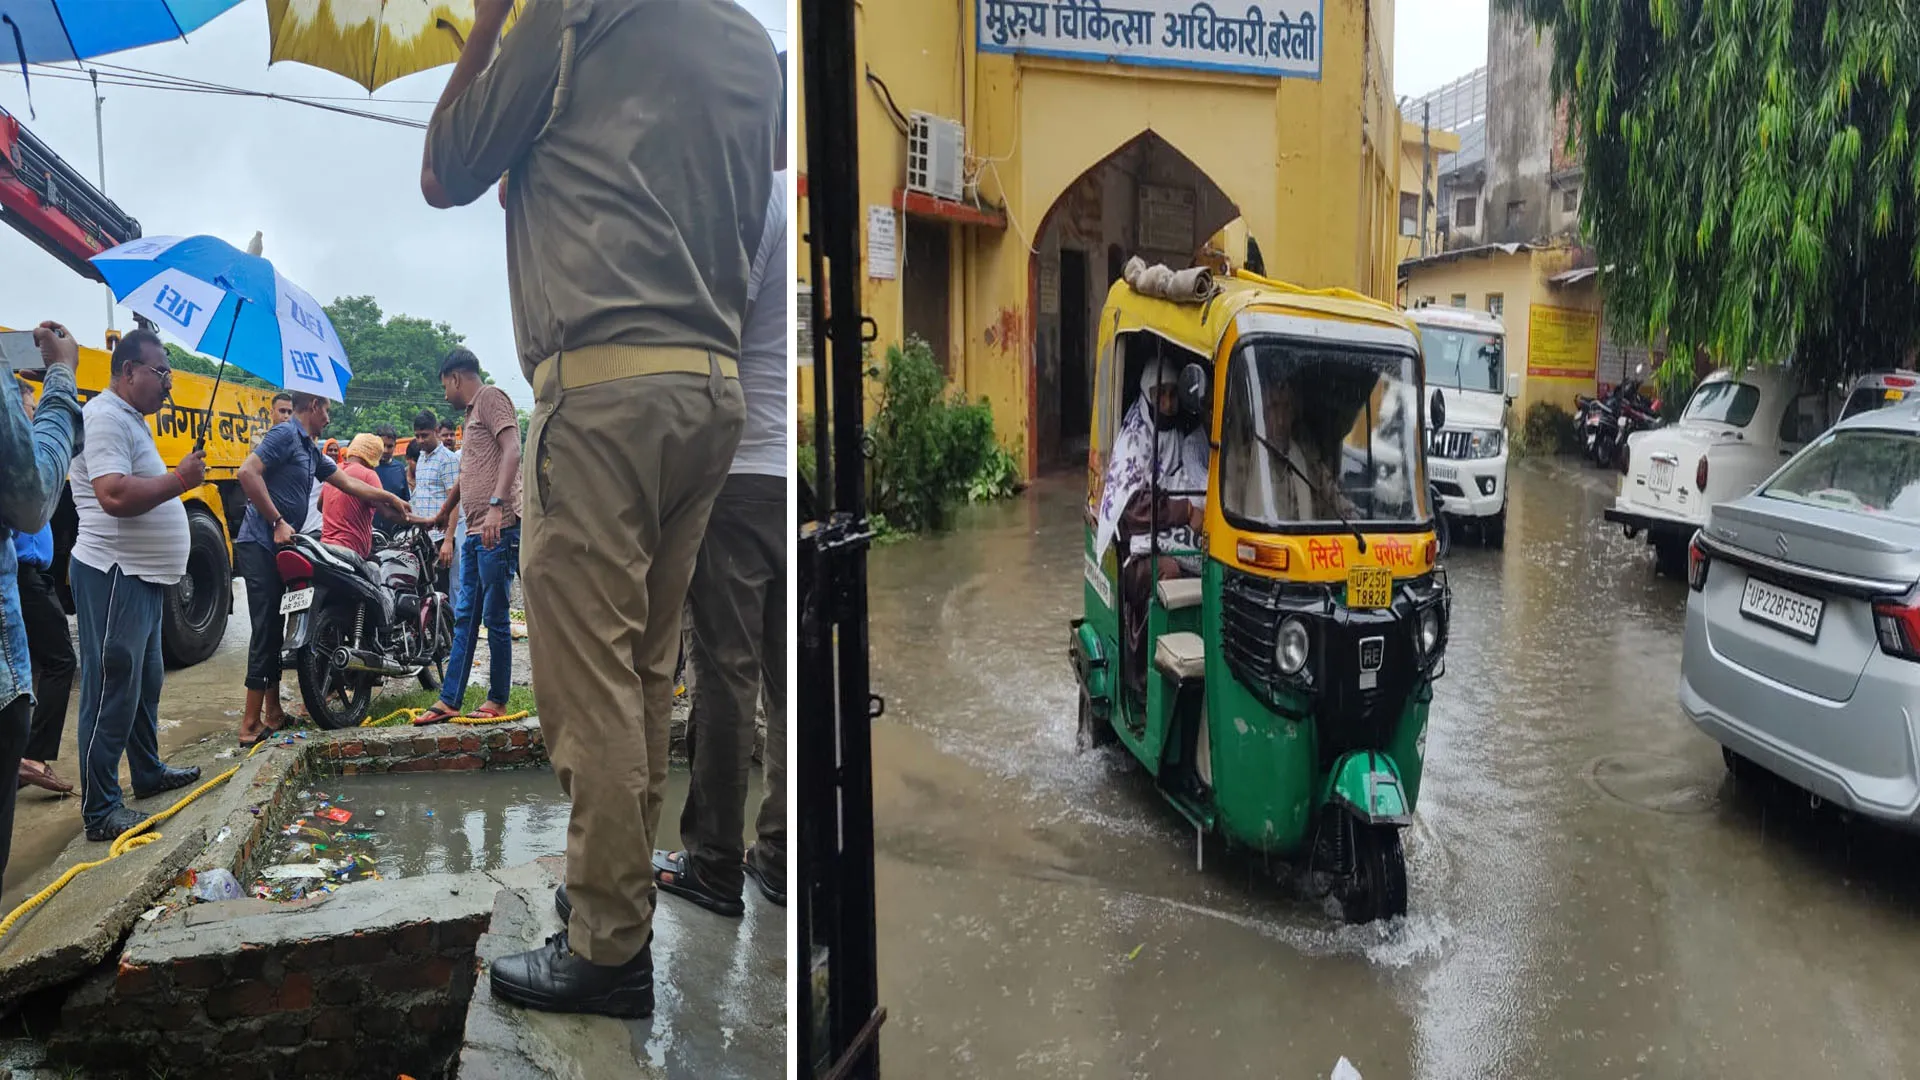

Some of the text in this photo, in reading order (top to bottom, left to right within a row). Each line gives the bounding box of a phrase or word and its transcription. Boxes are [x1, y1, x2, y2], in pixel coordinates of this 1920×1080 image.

[1052, 0, 1156, 46] चिकित्सा
[1308, 537, 1345, 570] सिटी
[1356, 589, 1387, 605] T8828
[1749, 584, 1819, 629] UP22BF5556
[1363, 647, 1381, 667] RE
